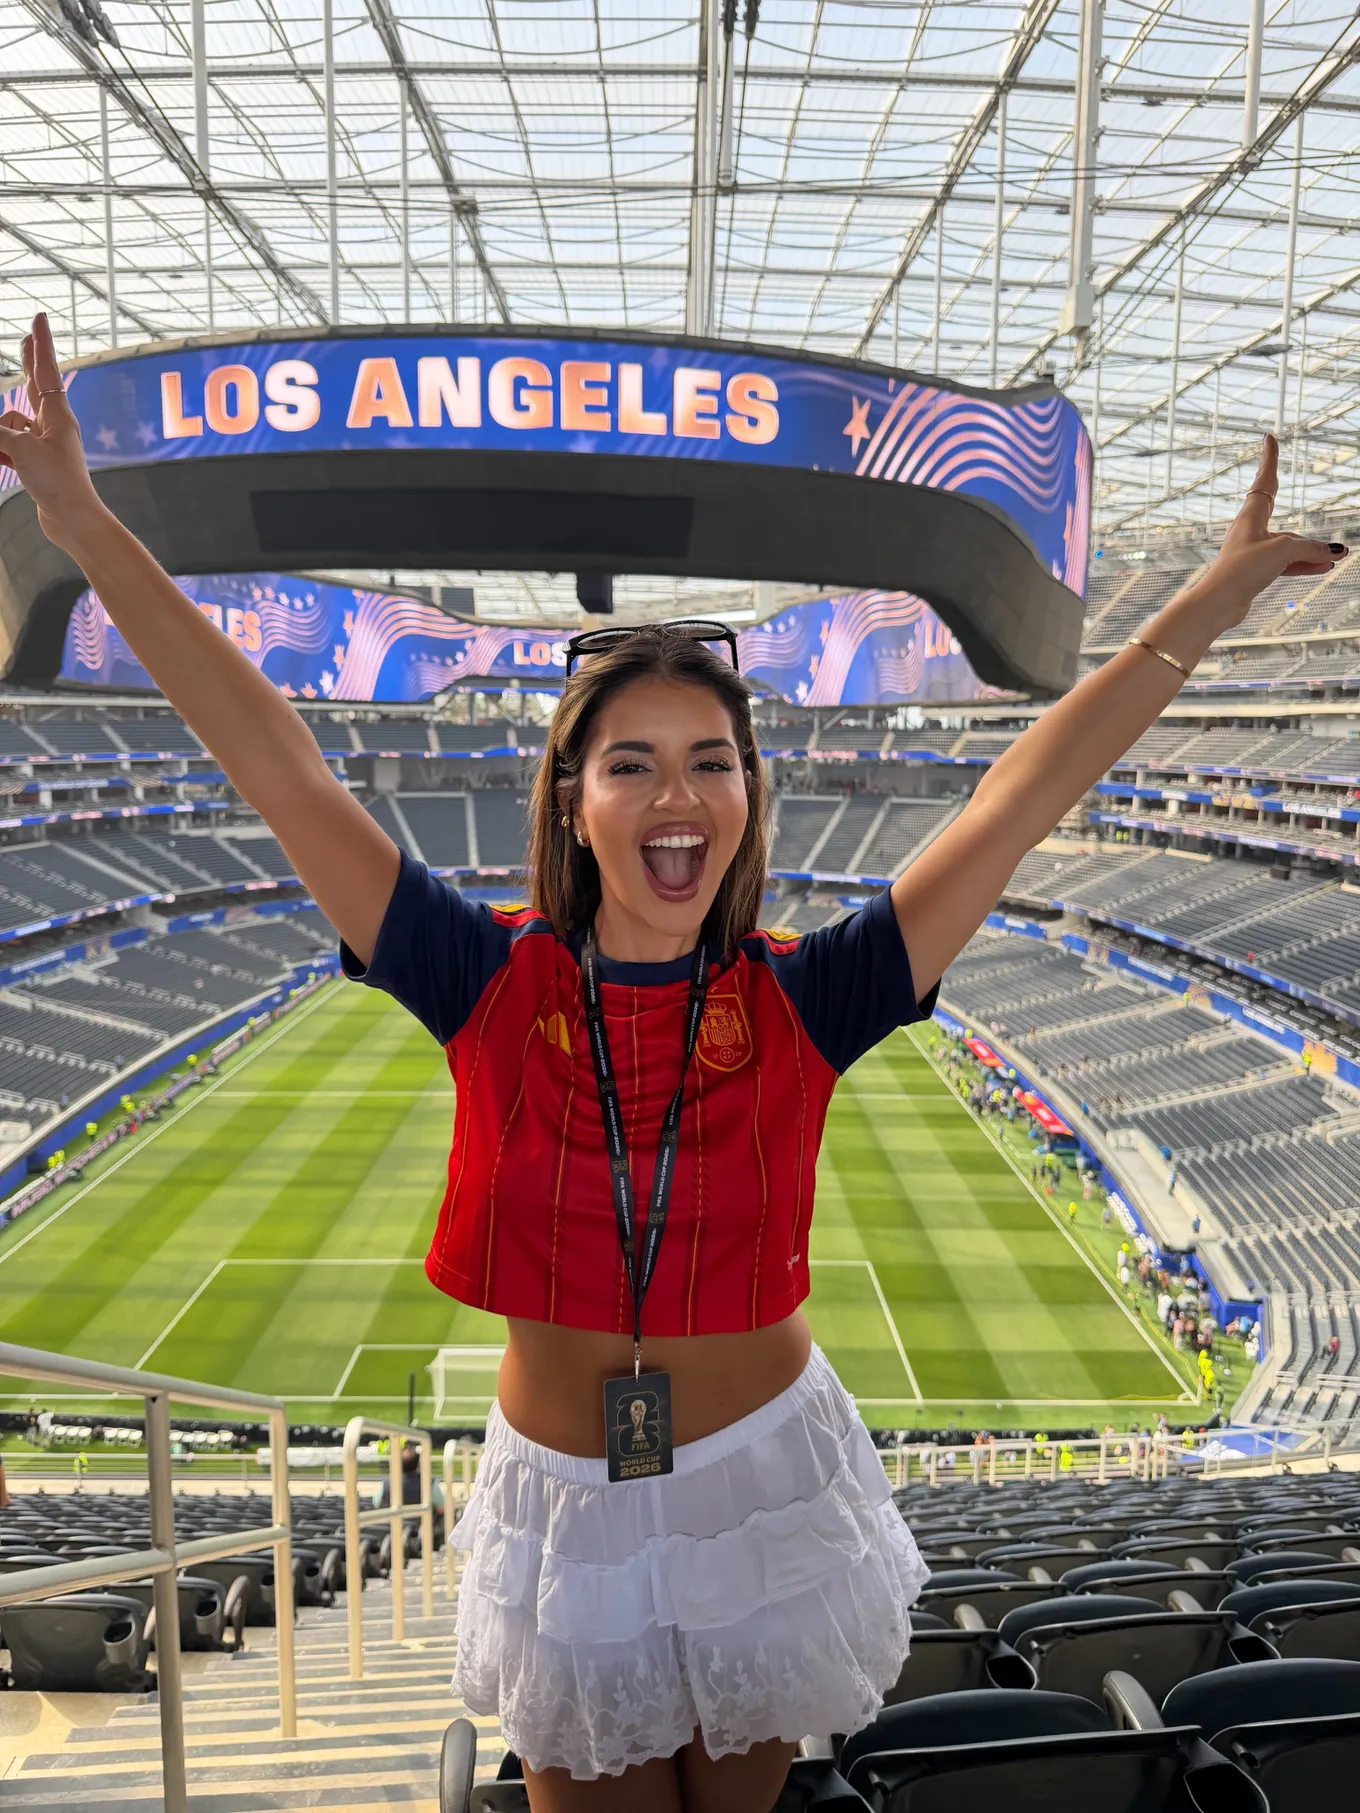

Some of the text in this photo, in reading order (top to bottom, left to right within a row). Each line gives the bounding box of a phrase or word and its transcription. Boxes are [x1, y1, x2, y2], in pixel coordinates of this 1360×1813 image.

[161, 356, 780, 445] LOS ANGELES
[658, 1176, 666, 1196] WORLD
[662, 1145, 670, 1167] 2026
[632, 1442, 650, 1451] FIFA
[620, 1456, 660, 1467] WORLD CUP
[620, 1463, 661, 1476] 2026
